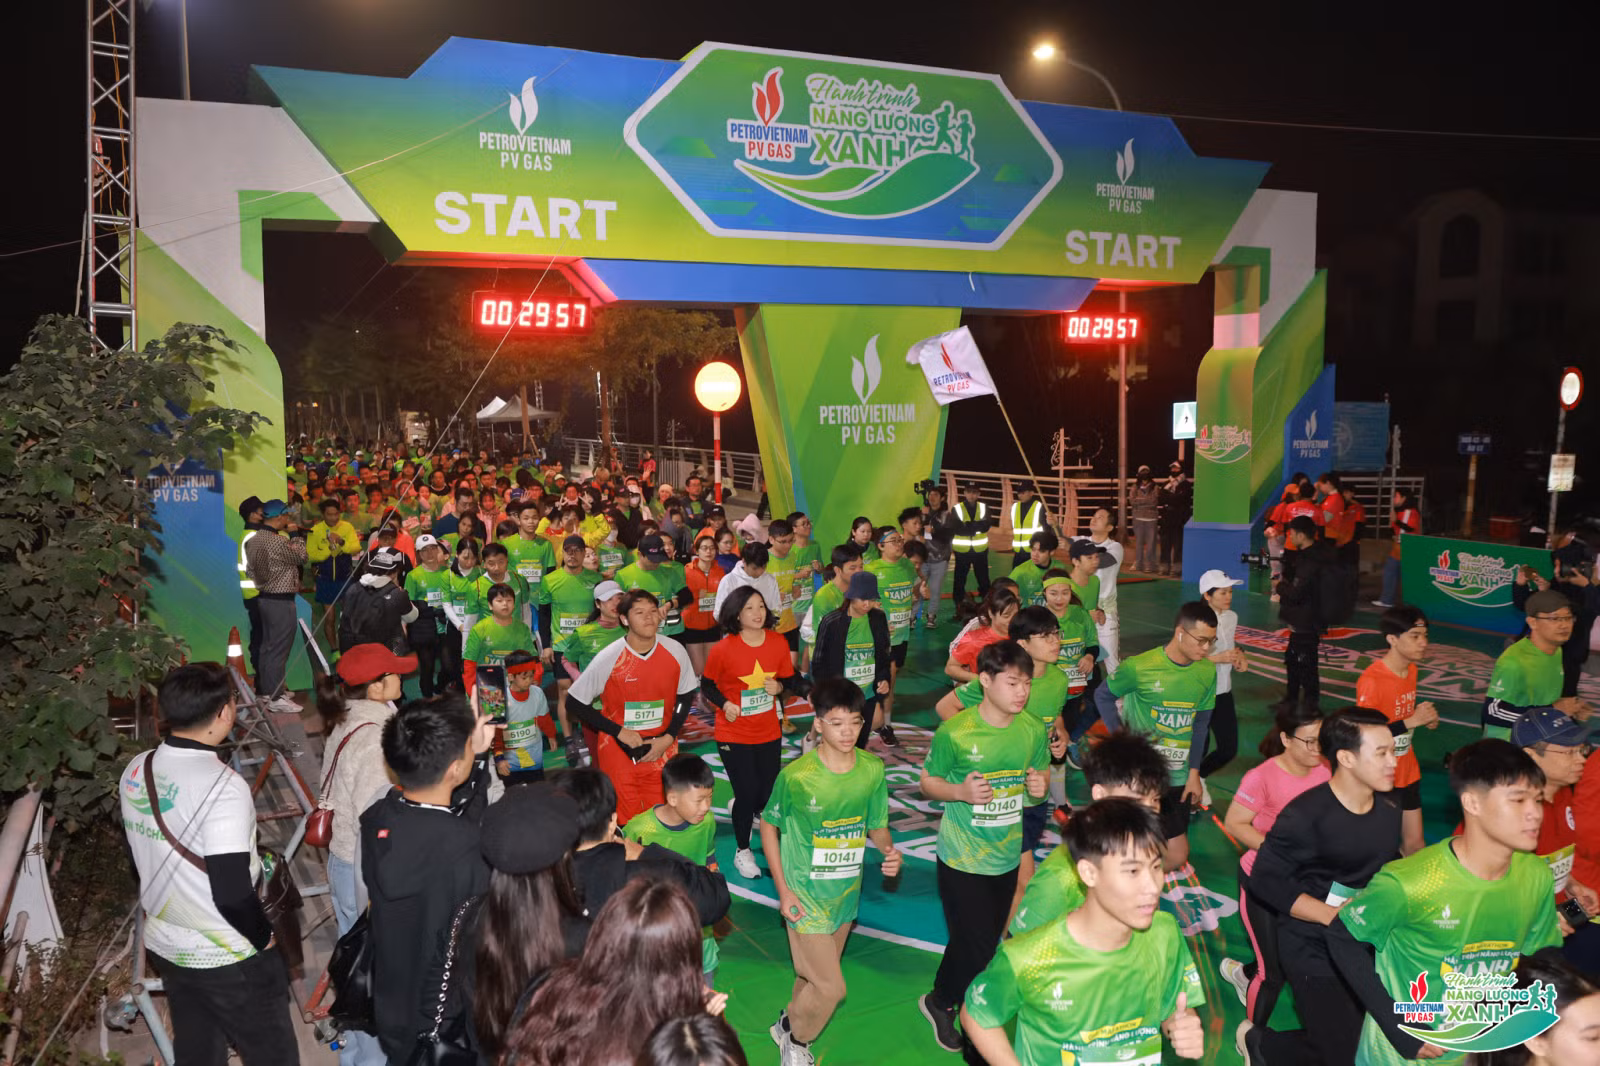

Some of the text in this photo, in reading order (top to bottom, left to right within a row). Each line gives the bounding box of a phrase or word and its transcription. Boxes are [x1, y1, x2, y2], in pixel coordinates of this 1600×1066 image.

[813, 103, 935, 139] NĂNG LƯỢNG
[731, 123, 808, 144] PETROVIETNAM
[479, 132, 571, 155] PETROVIETNAM
[748, 141, 792, 158] PV GAS
[813, 133, 909, 167] XANH
[500, 152, 553, 171] PV GAS
[1096, 183, 1155, 200] PETROVIETNAM
[1109, 198, 1142, 214] PV GAS
[434, 191, 617, 240] START
[1065, 229, 1182, 269] START
[819, 404, 915, 425] PETROVIETNAM
[842, 425, 895, 445] PV GAS
[154, 489, 198, 502] PV GAS
[1462, 574, 1501, 588] XANH
[851, 667, 872, 677] 5446
[750, 694, 769, 705] 5172
[635, 711, 655, 720] 5171
[510, 728, 531, 739] 5190
[984, 799, 1017, 812] 10140
[824, 851, 857, 864] 10141
